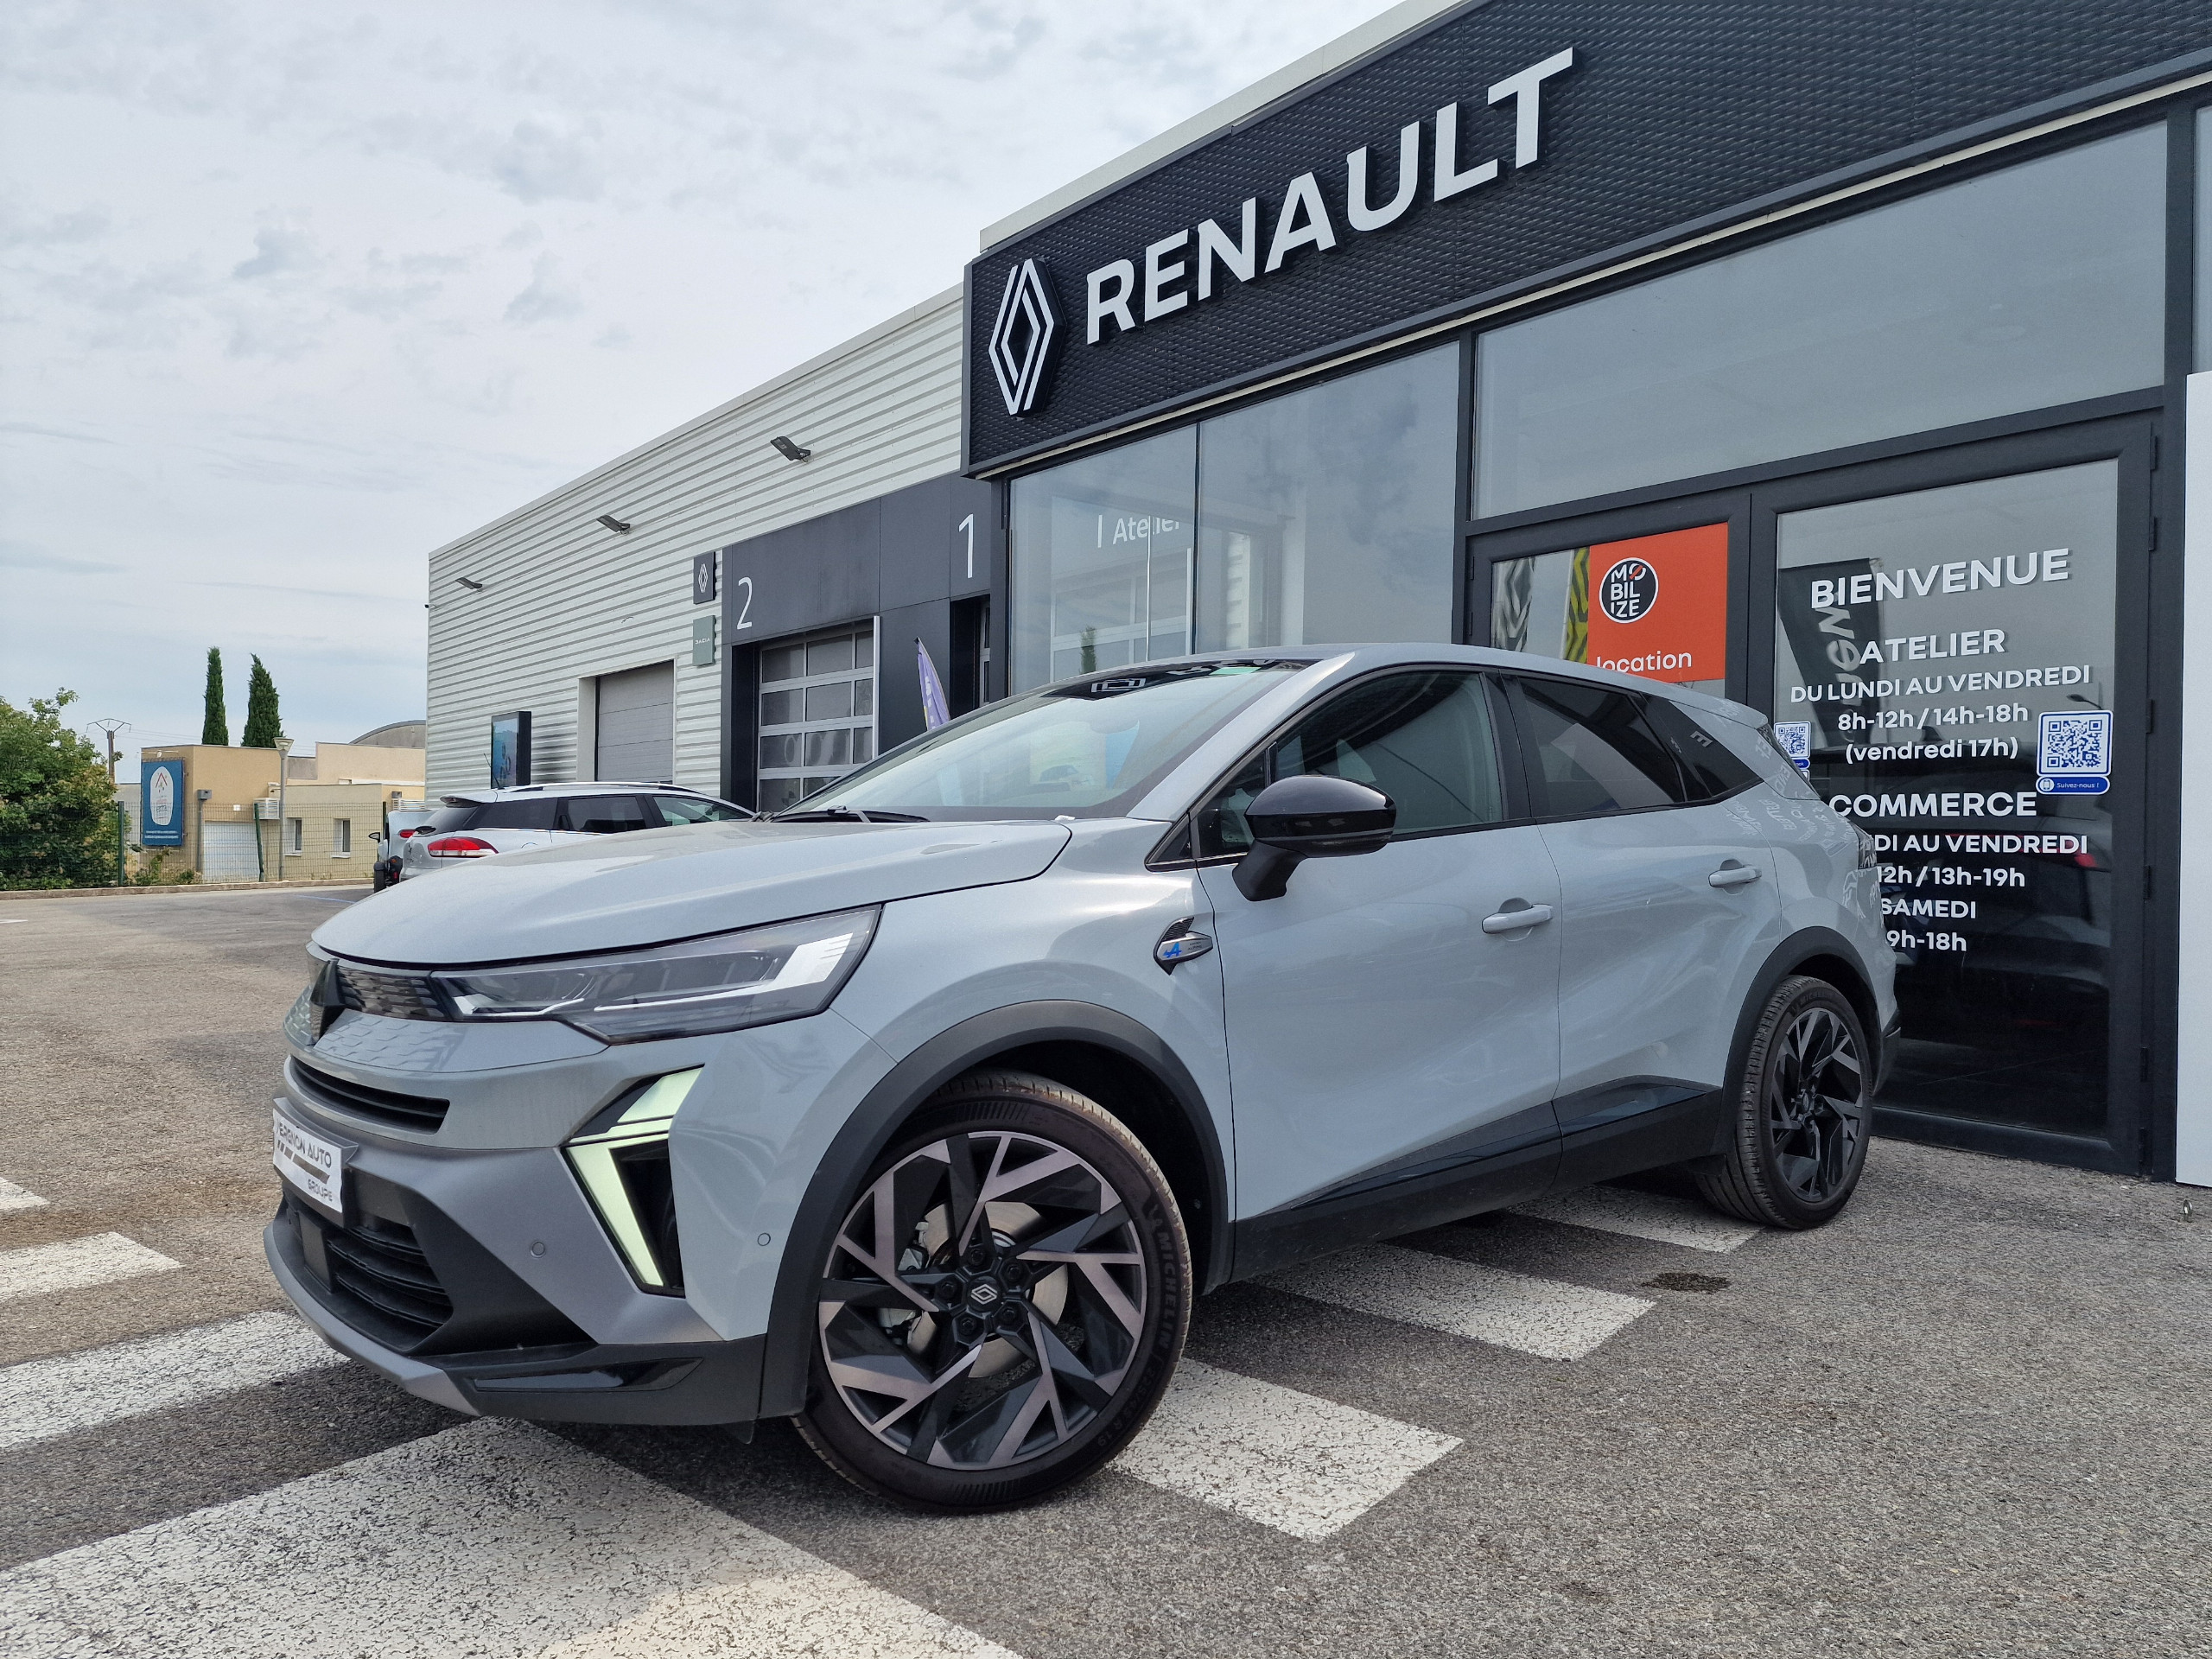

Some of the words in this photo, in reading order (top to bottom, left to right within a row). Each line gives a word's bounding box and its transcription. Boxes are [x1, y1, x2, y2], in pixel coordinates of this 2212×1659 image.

[1086, 47, 1573, 345] RENAULT
[957, 513, 975, 579] 1
[1610, 582, 1641, 601] BIL
[1810, 548, 2069, 609] BIENVENUE
[736, 576, 753, 630] 2
[1610, 599, 1640, 618] IZE
[1859, 628, 2005, 664] ATELIER
[1596, 650, 1693, 674] location
[1790, 684, 1822, 703] DU
[1827, 677, 1901, 701] LUNDI
[1905, 675, 1944, 696] AU
[1948, 664, 2090, 694] VENDREDI
[1837, 711, 1915, 732] 8h-12h
[1933, 702, 2029, 728] 14h-18h
[1845, 738, 1964, 765] (vendredi
[1968, 736, 2019, 760] 17h)
[1828, 791, 2037, 817] COMMERCE
[1872, 835, 1898, 853] DI
[1903, 834, 1940, 853] AU
[1944, 835, 2088, 855] VENDREDI
[1931, 867, 2025, 887] 13h-19h
[1879, 897, 1977, 919] SAMEDI
[1885, 930, 1967, 952] 9h-18h
[308, 1143, 332, 1168] AUTO
[308, 1179, 333, 1201] GROUPE
[1158, 1232, 1177, 1349] MICHELIN
